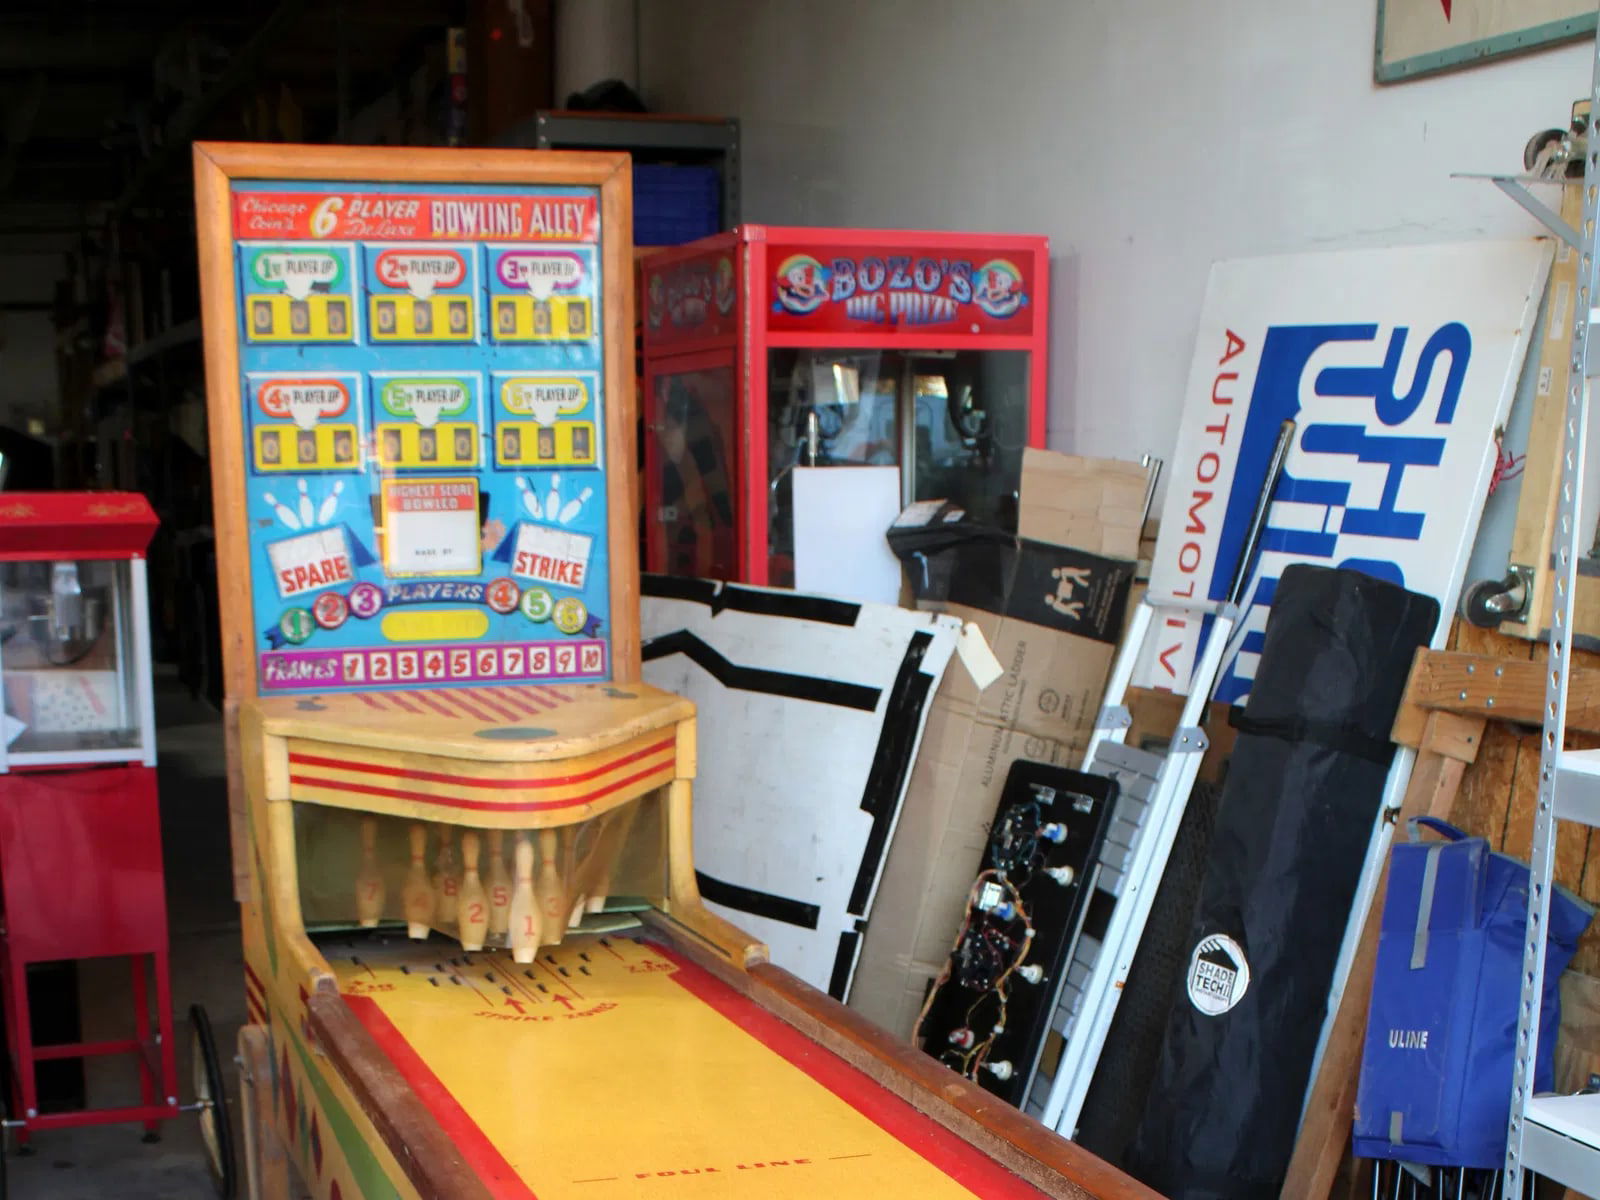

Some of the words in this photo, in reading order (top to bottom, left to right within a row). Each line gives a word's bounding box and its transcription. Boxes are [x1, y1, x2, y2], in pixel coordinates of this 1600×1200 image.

[310, 196, 345, 238] 6
[348, 200, 420, 218] PLAYER
[430, 201, 522, 238] BOWLING
[529, 203, 586, 238] ALLEY
[286, 259, 319, 274] PLAYER
[320, 259, 334, 274] UP
[410, 260, 442, 275] PLAYER
[443, 260, 456, 275] UP
[531, 261, 562, 276] PLAYER
[830, 256, 974, 305] BOZO'S
[292, 389, 325, 404] PLAYER
[327, 389, 340, 403] UP
[416, 389, 447, 403] PLAYER
[449, 388, 461, 403] UP
[536, 388, 565, 402] PLAYER
[567, 388, 579, 402] UP
[1155, 329, 1246, 694] AUTOMOTIV
[281, 555, 351, 594] SPARE
[516, 551, 583, 587] STRIKE
[323, 598, 339, 622] 2
[357, 588, 375, 612] 3
[387, 584, 484, 602] PLAYERS
[494, 585, 510, 608] 4
[529, 592, 546, 613] 5
[561, 602, 578, 626] 6
[374, 657, 388, 677] 2
[401, 655, 415, 676] 3
[427, 655, 443, 676] 4
[454, 653, 468, 674] 5
[479, 653, 495, 673] 6
[507, 652, 521, 673] 7
[533, 651, 547, 671] 8
[558, 651, 572, 671] 9
[583, 649, 599, 669] 10
[1008, 640, 1028, 688] LADDER
[493, 887, 507, 907] 5
[469, 904, 484, 924] 2
[523, 915, 536, 937] 1
[1197, 961, 1234, 986] SHADE
[474, 1011, 554, 1022] STRIKE
[1388, 1029, 1429, 1050] ULINE
[634, 1167, 721, 1179] FOUL
[736, 1159, 812, 1170] LINE
